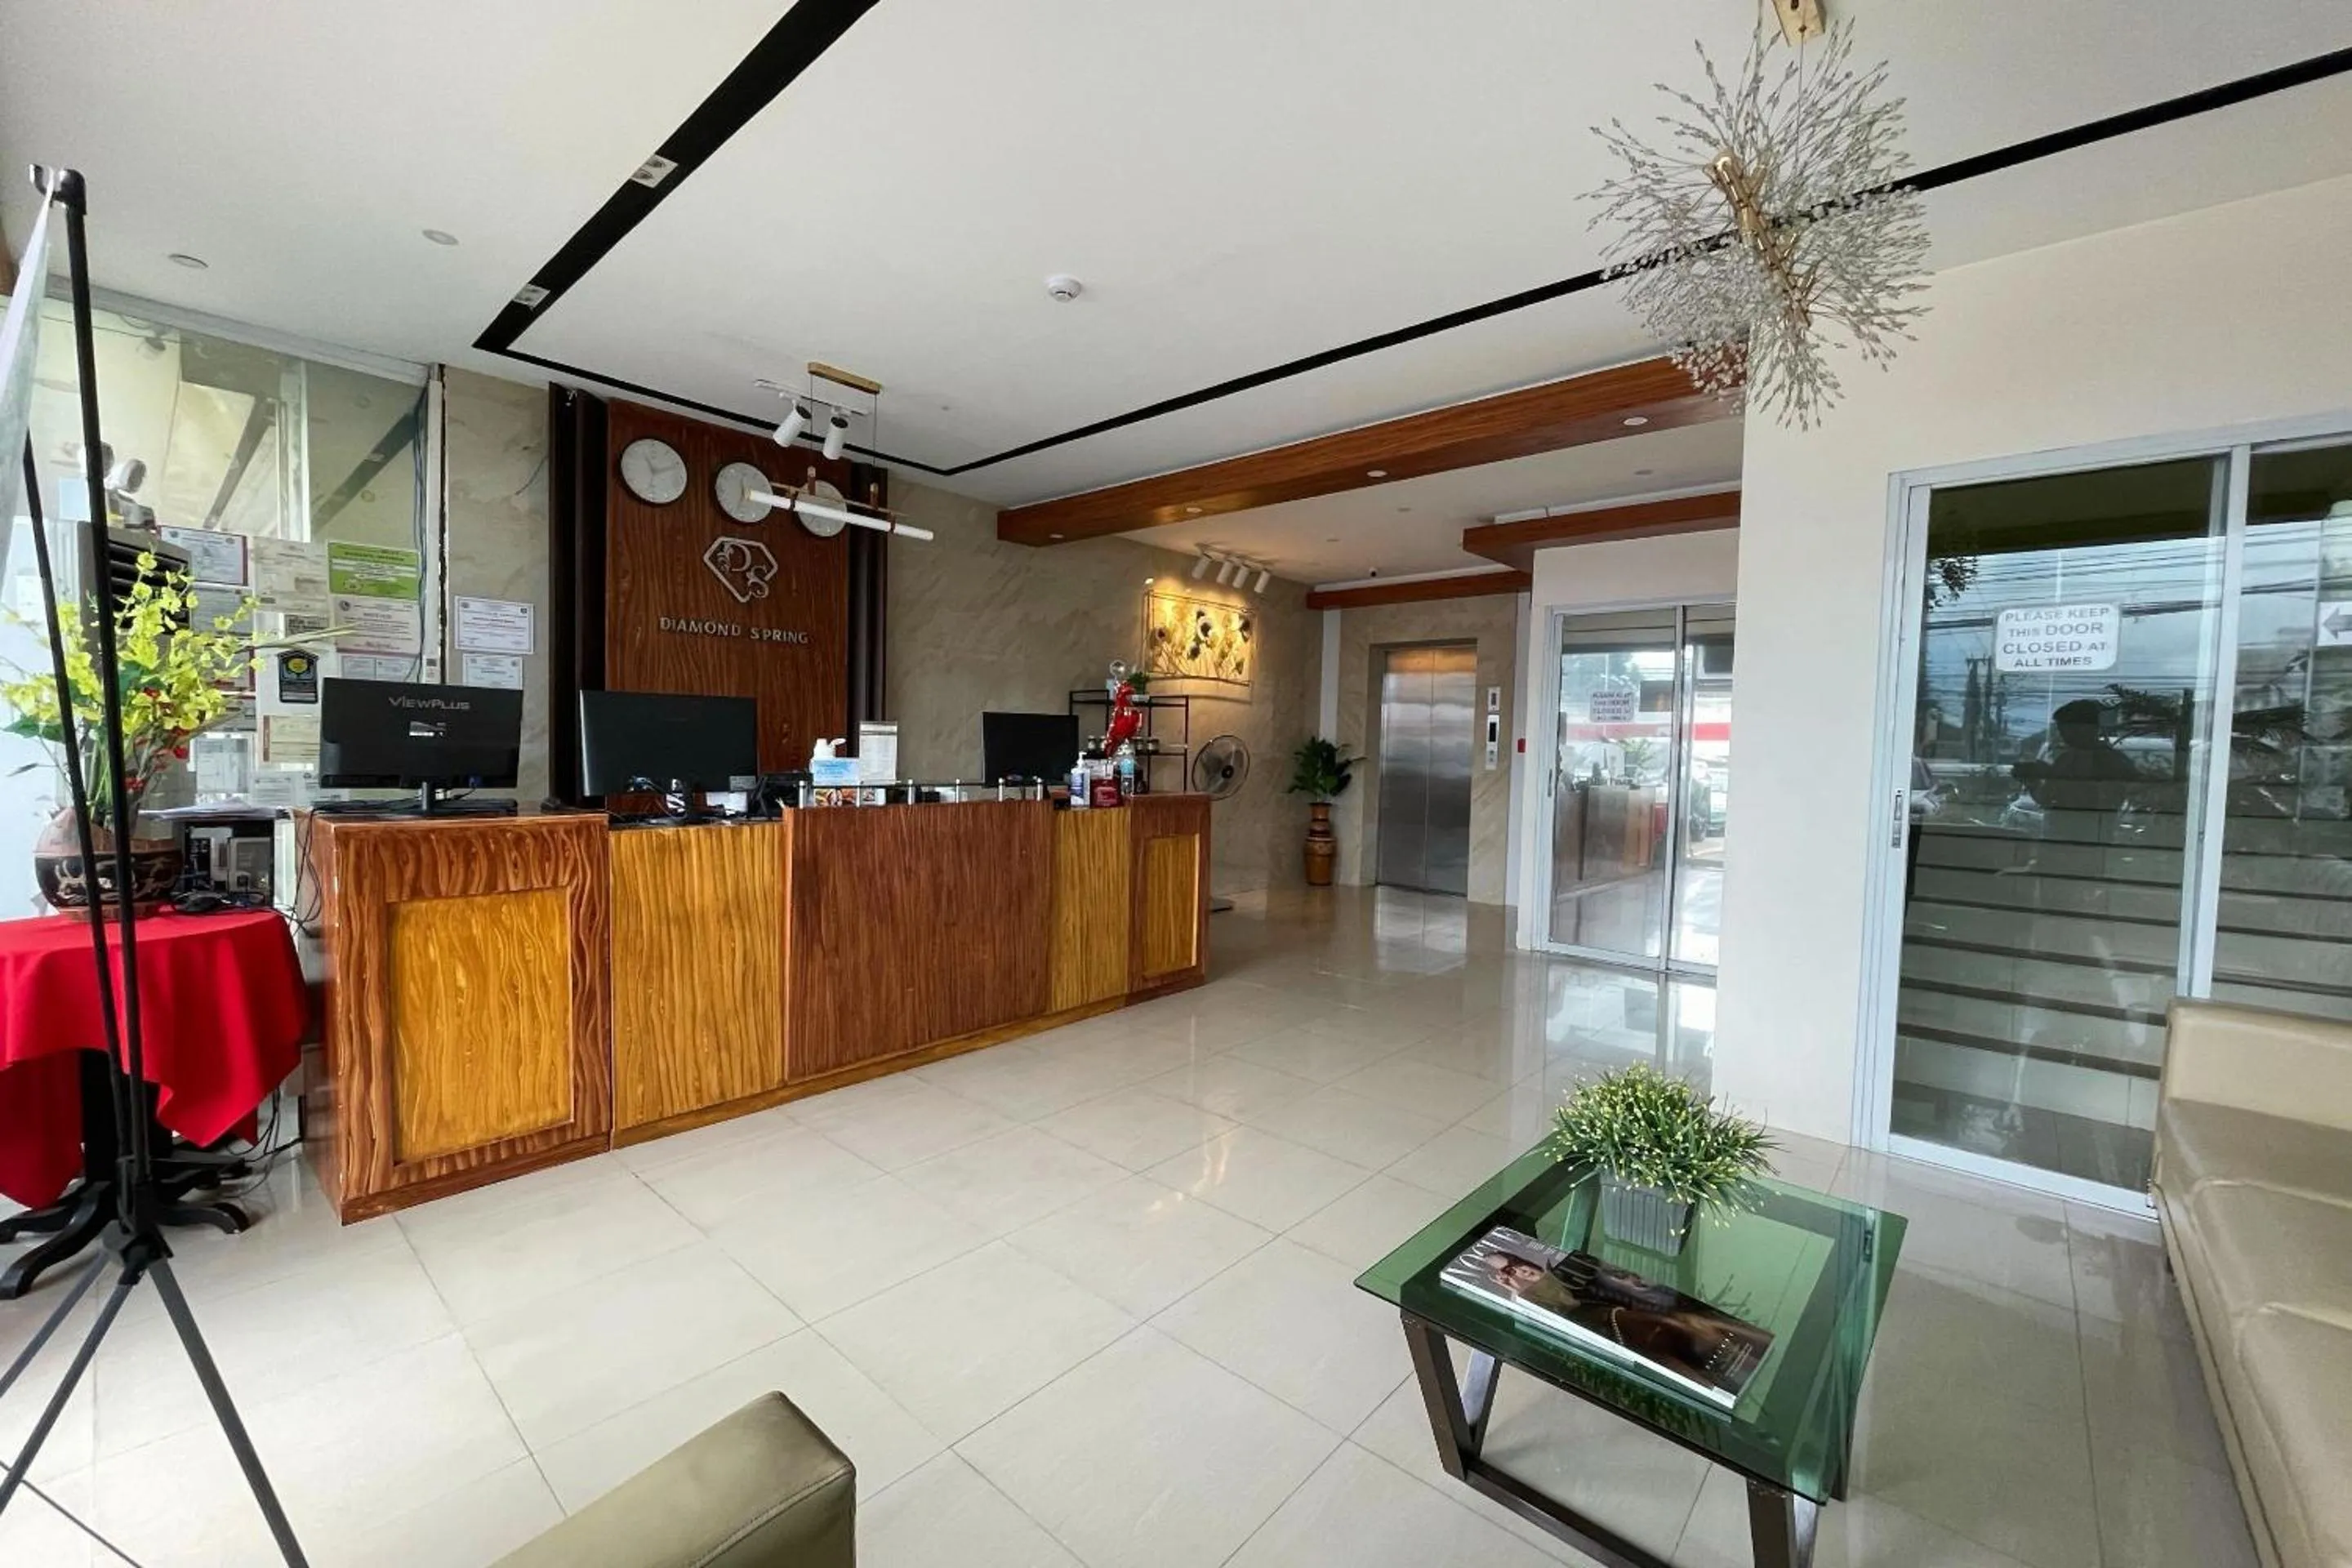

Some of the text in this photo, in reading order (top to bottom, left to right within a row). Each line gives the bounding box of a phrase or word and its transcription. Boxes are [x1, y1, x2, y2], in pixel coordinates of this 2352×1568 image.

[2005, 607, 2109, 621] PLEASE KEEP
[659, 616, 808, 644] DIAMOND SPRING
[2007, 621, 2104, 637] THIS DOOR
[2003, 640, 2107, 654] CLOSED AT
[2014, 656, 2092, 668] ALL TIMES
